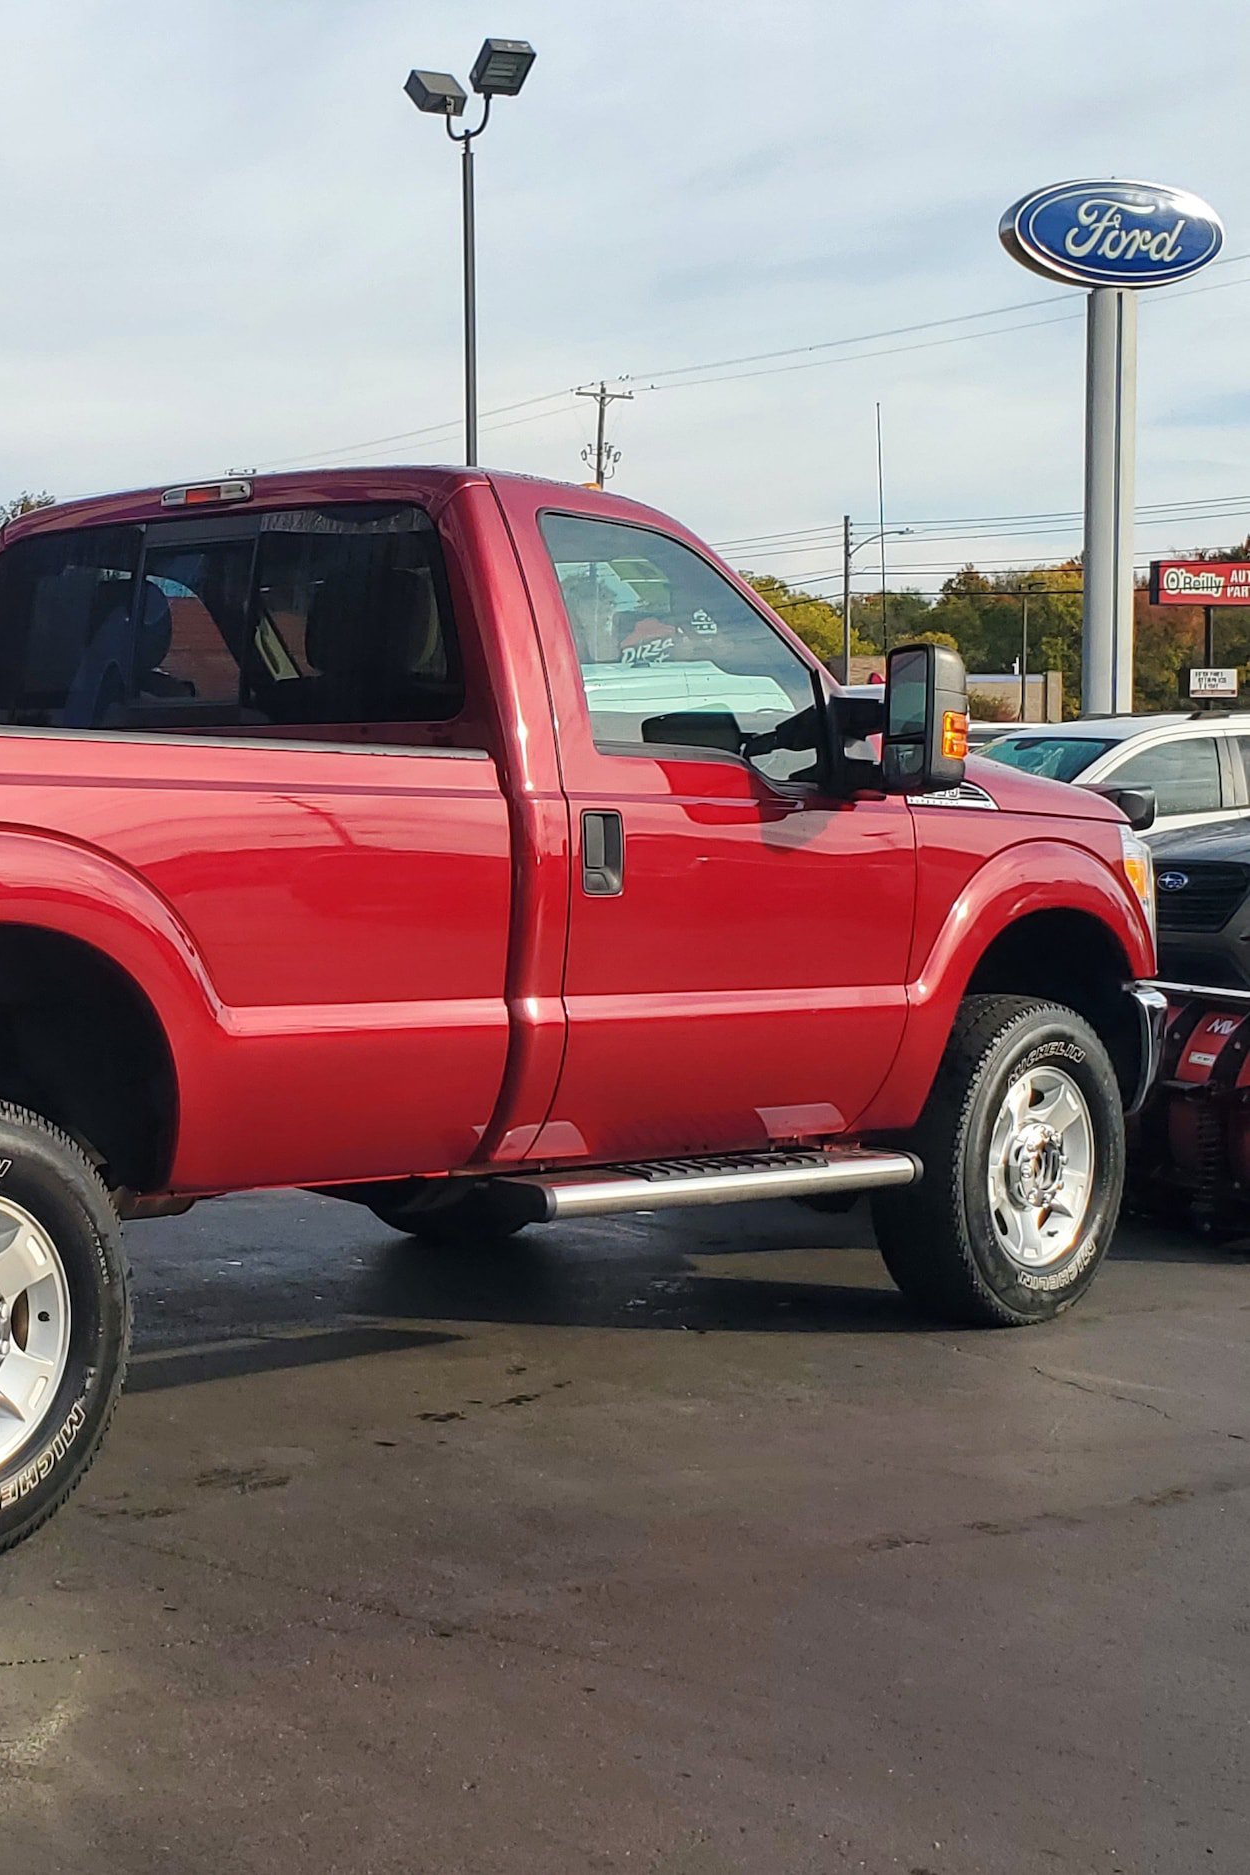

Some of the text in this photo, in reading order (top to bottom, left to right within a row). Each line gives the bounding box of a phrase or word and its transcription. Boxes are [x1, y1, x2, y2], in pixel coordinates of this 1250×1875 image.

[1064, 198, 1186, 262] Ford
[1163, 567, 1224, 597] O'Reilly
[1007, 1040, 1086, 1089] MICHELIN
[1019, 1239, 1097, 1292] MICHELIN
